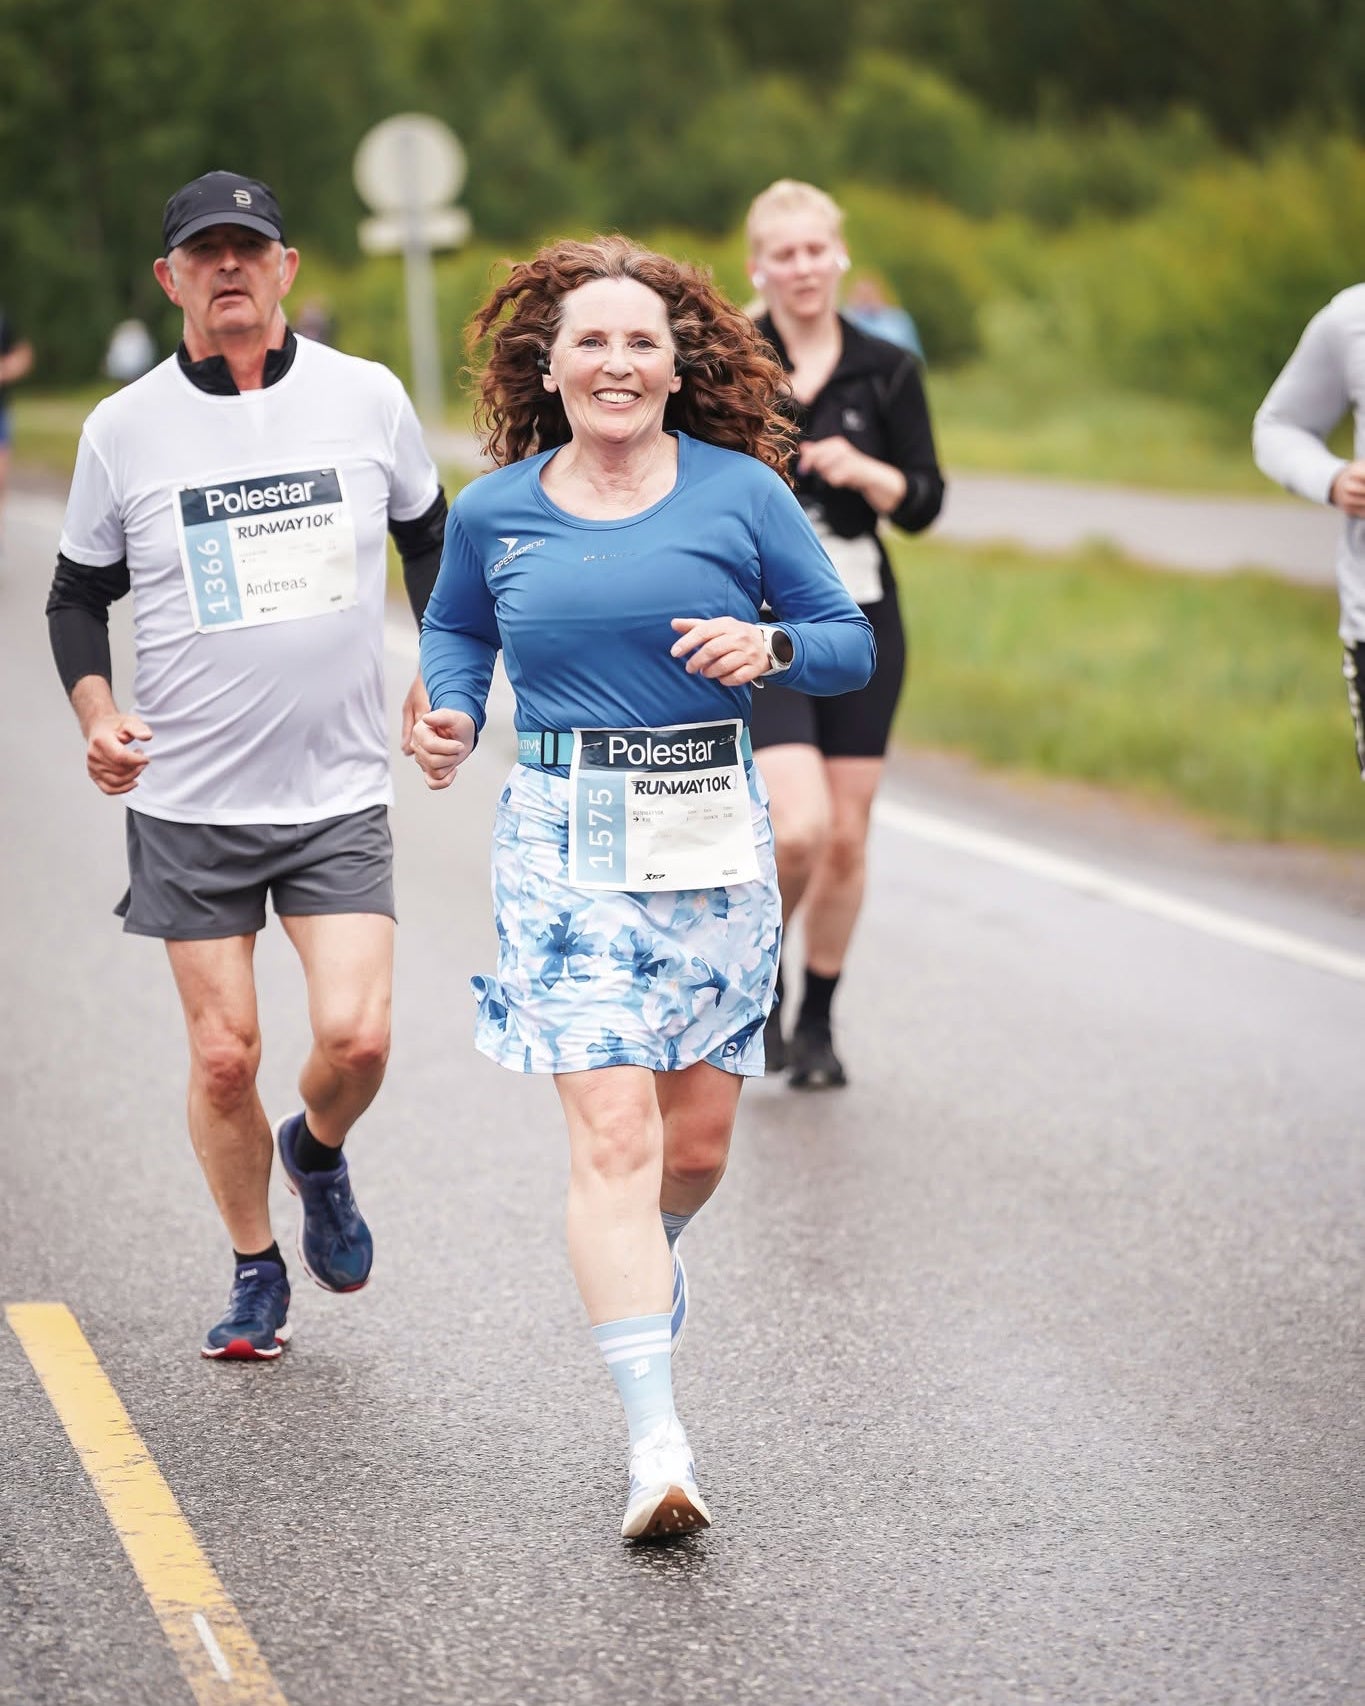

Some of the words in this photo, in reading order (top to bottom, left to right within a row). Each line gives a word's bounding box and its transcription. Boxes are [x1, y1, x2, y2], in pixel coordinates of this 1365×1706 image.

[205, 480, 315, 517] Polestar
[235, 512, 335, 540] RUNWAY10K
[196, 538, 231, 615] 1366
[246, 577, 308, 598] Andreas
[608, 735, 715, 766] Polestar
[631, 775, 732, 796] RUNWAY10K
[588, 788, 613, 869] 1575
